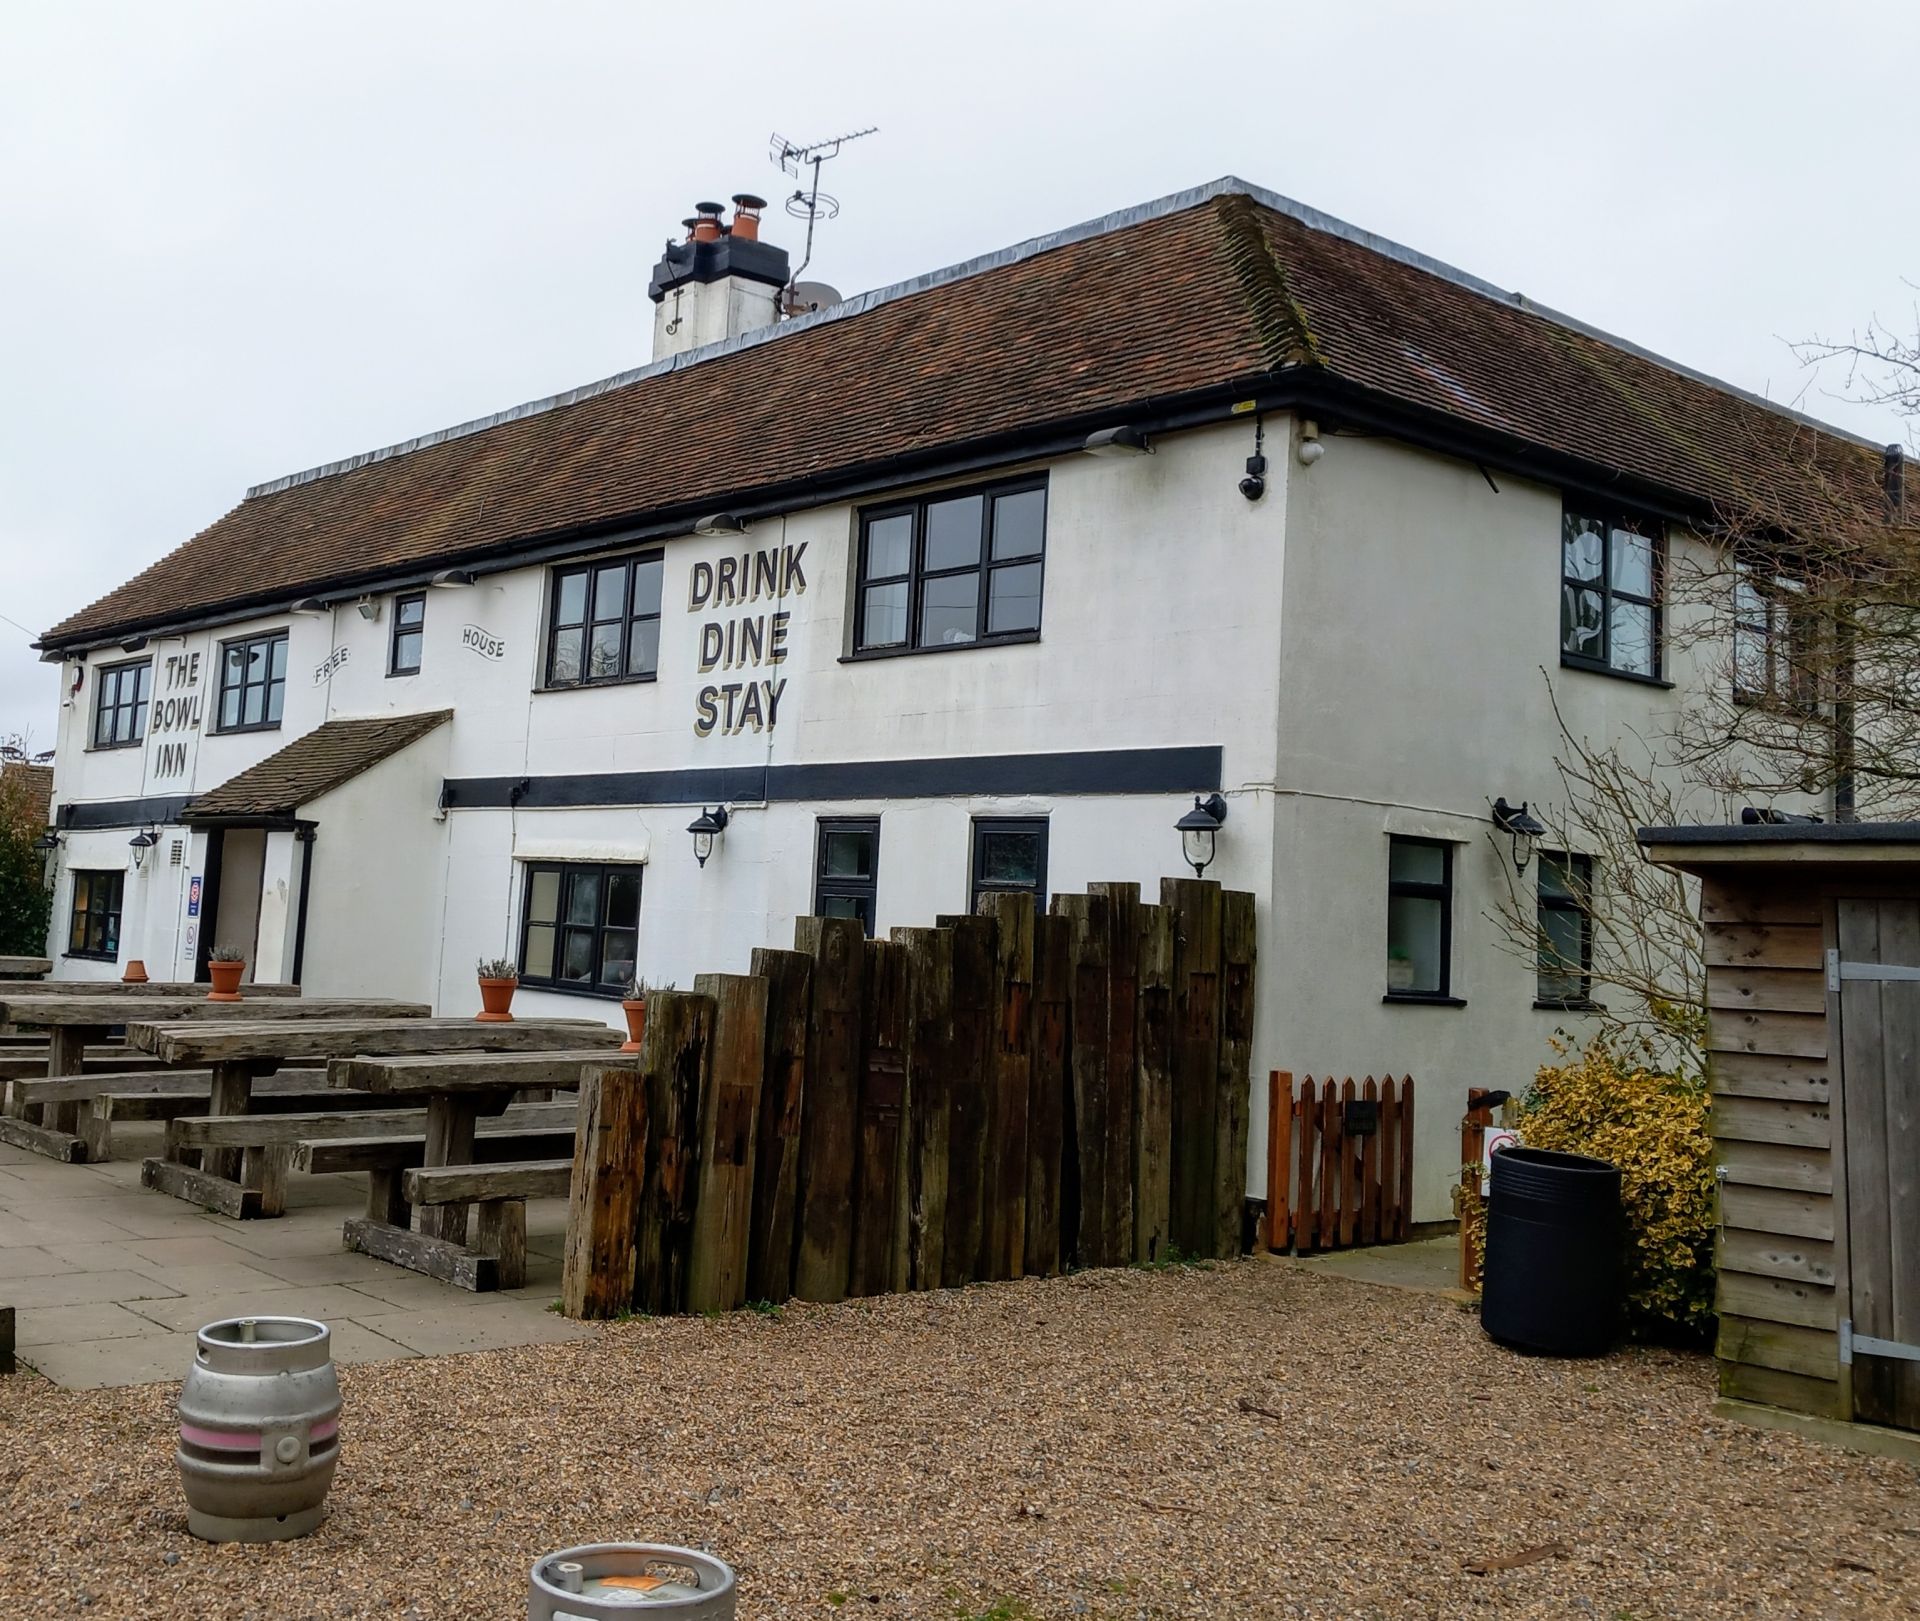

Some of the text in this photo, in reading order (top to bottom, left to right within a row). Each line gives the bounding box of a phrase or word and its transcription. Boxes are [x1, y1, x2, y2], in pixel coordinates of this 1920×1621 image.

[688, 541, 808, 612] DRINK
[315, 628, 505, 683] FREE HOUSE
[698, 611, 790, 673] DINE
[166, 652, 200, 691] THE
[151, 696, 200, 734] BOWL
[694, 678, 788, 738] STAY
[154, 742, 187, 778] INN
